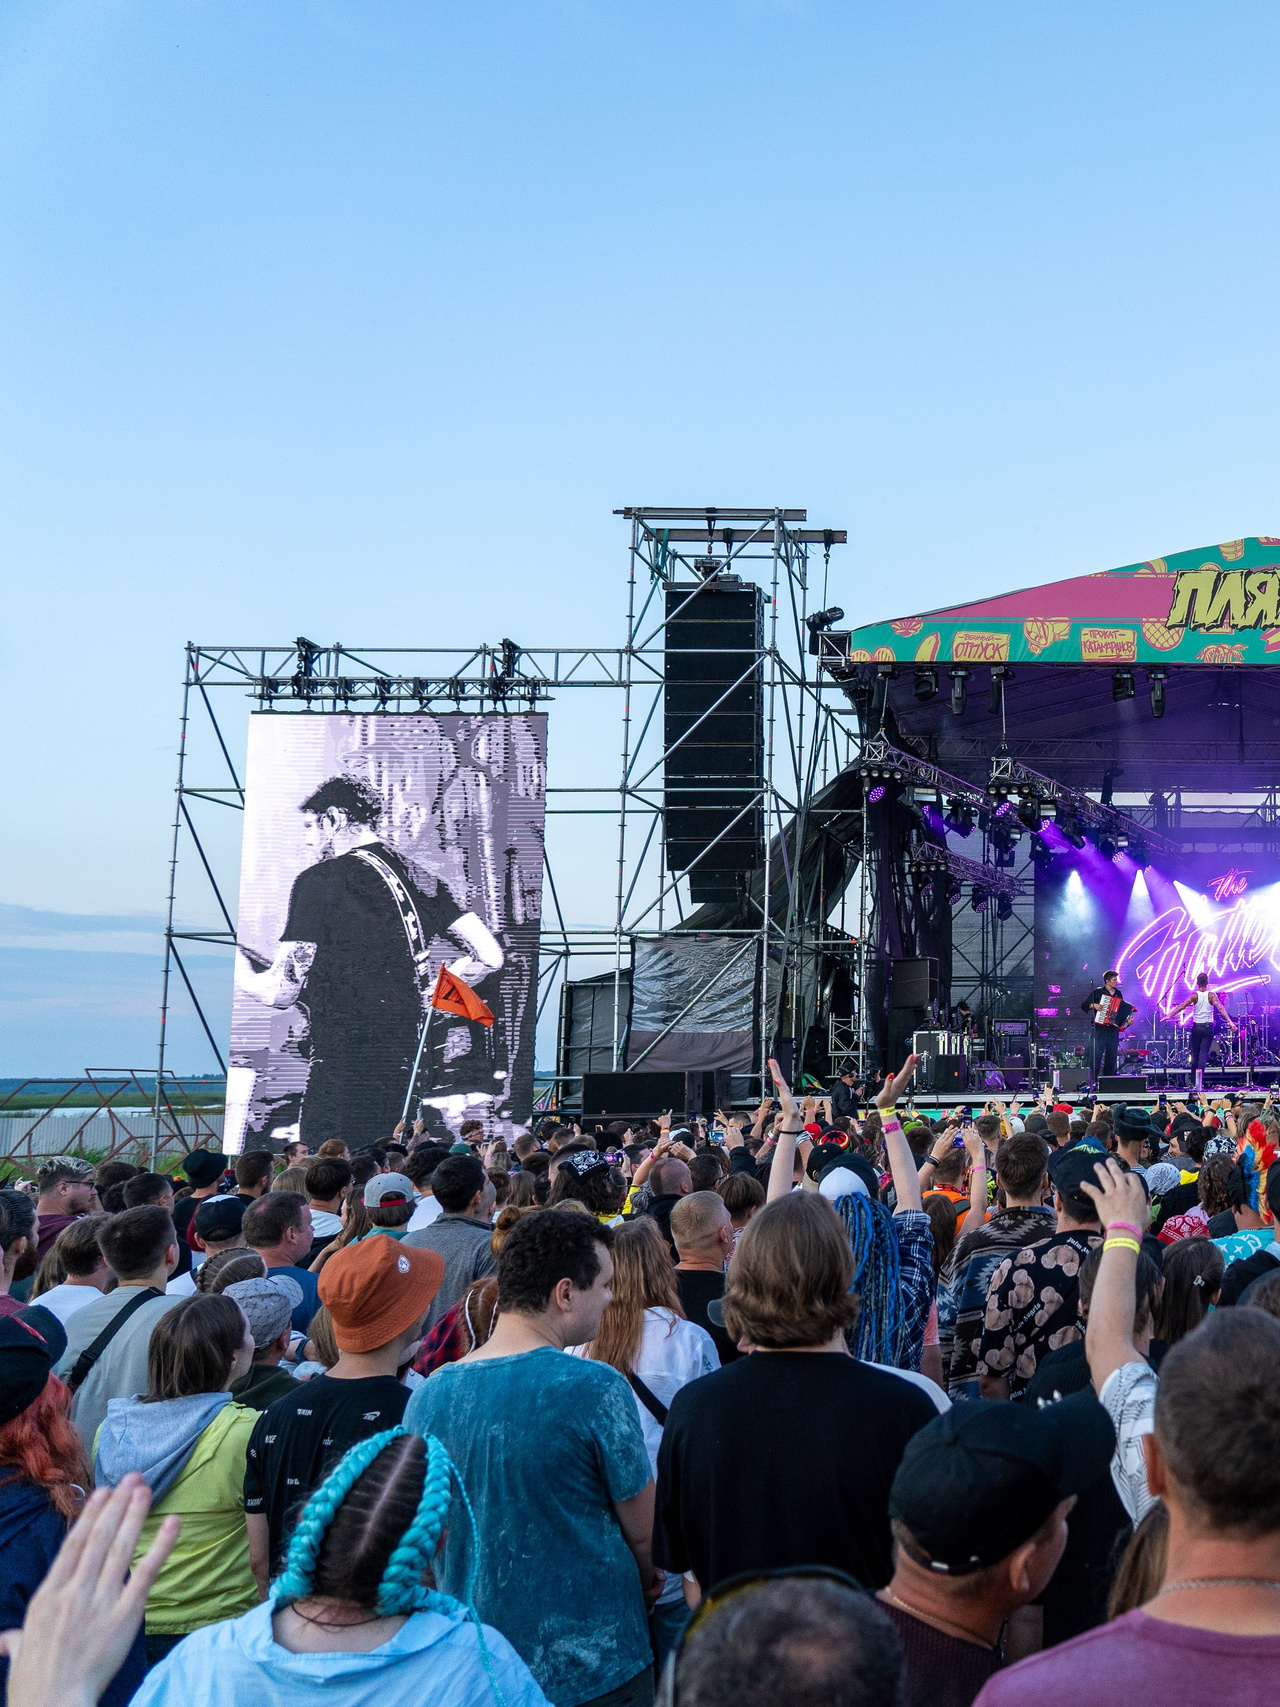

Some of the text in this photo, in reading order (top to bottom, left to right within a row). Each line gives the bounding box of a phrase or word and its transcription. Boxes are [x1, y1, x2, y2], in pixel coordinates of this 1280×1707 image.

[1089, 629, 1119, 639] ПРОКАТ
[954, 641, 1007, 661] ОТПУСК
[1083, 641, 1134, 654] КАТАМАРАНОВ
[1207, 867, 1254, 902] The
